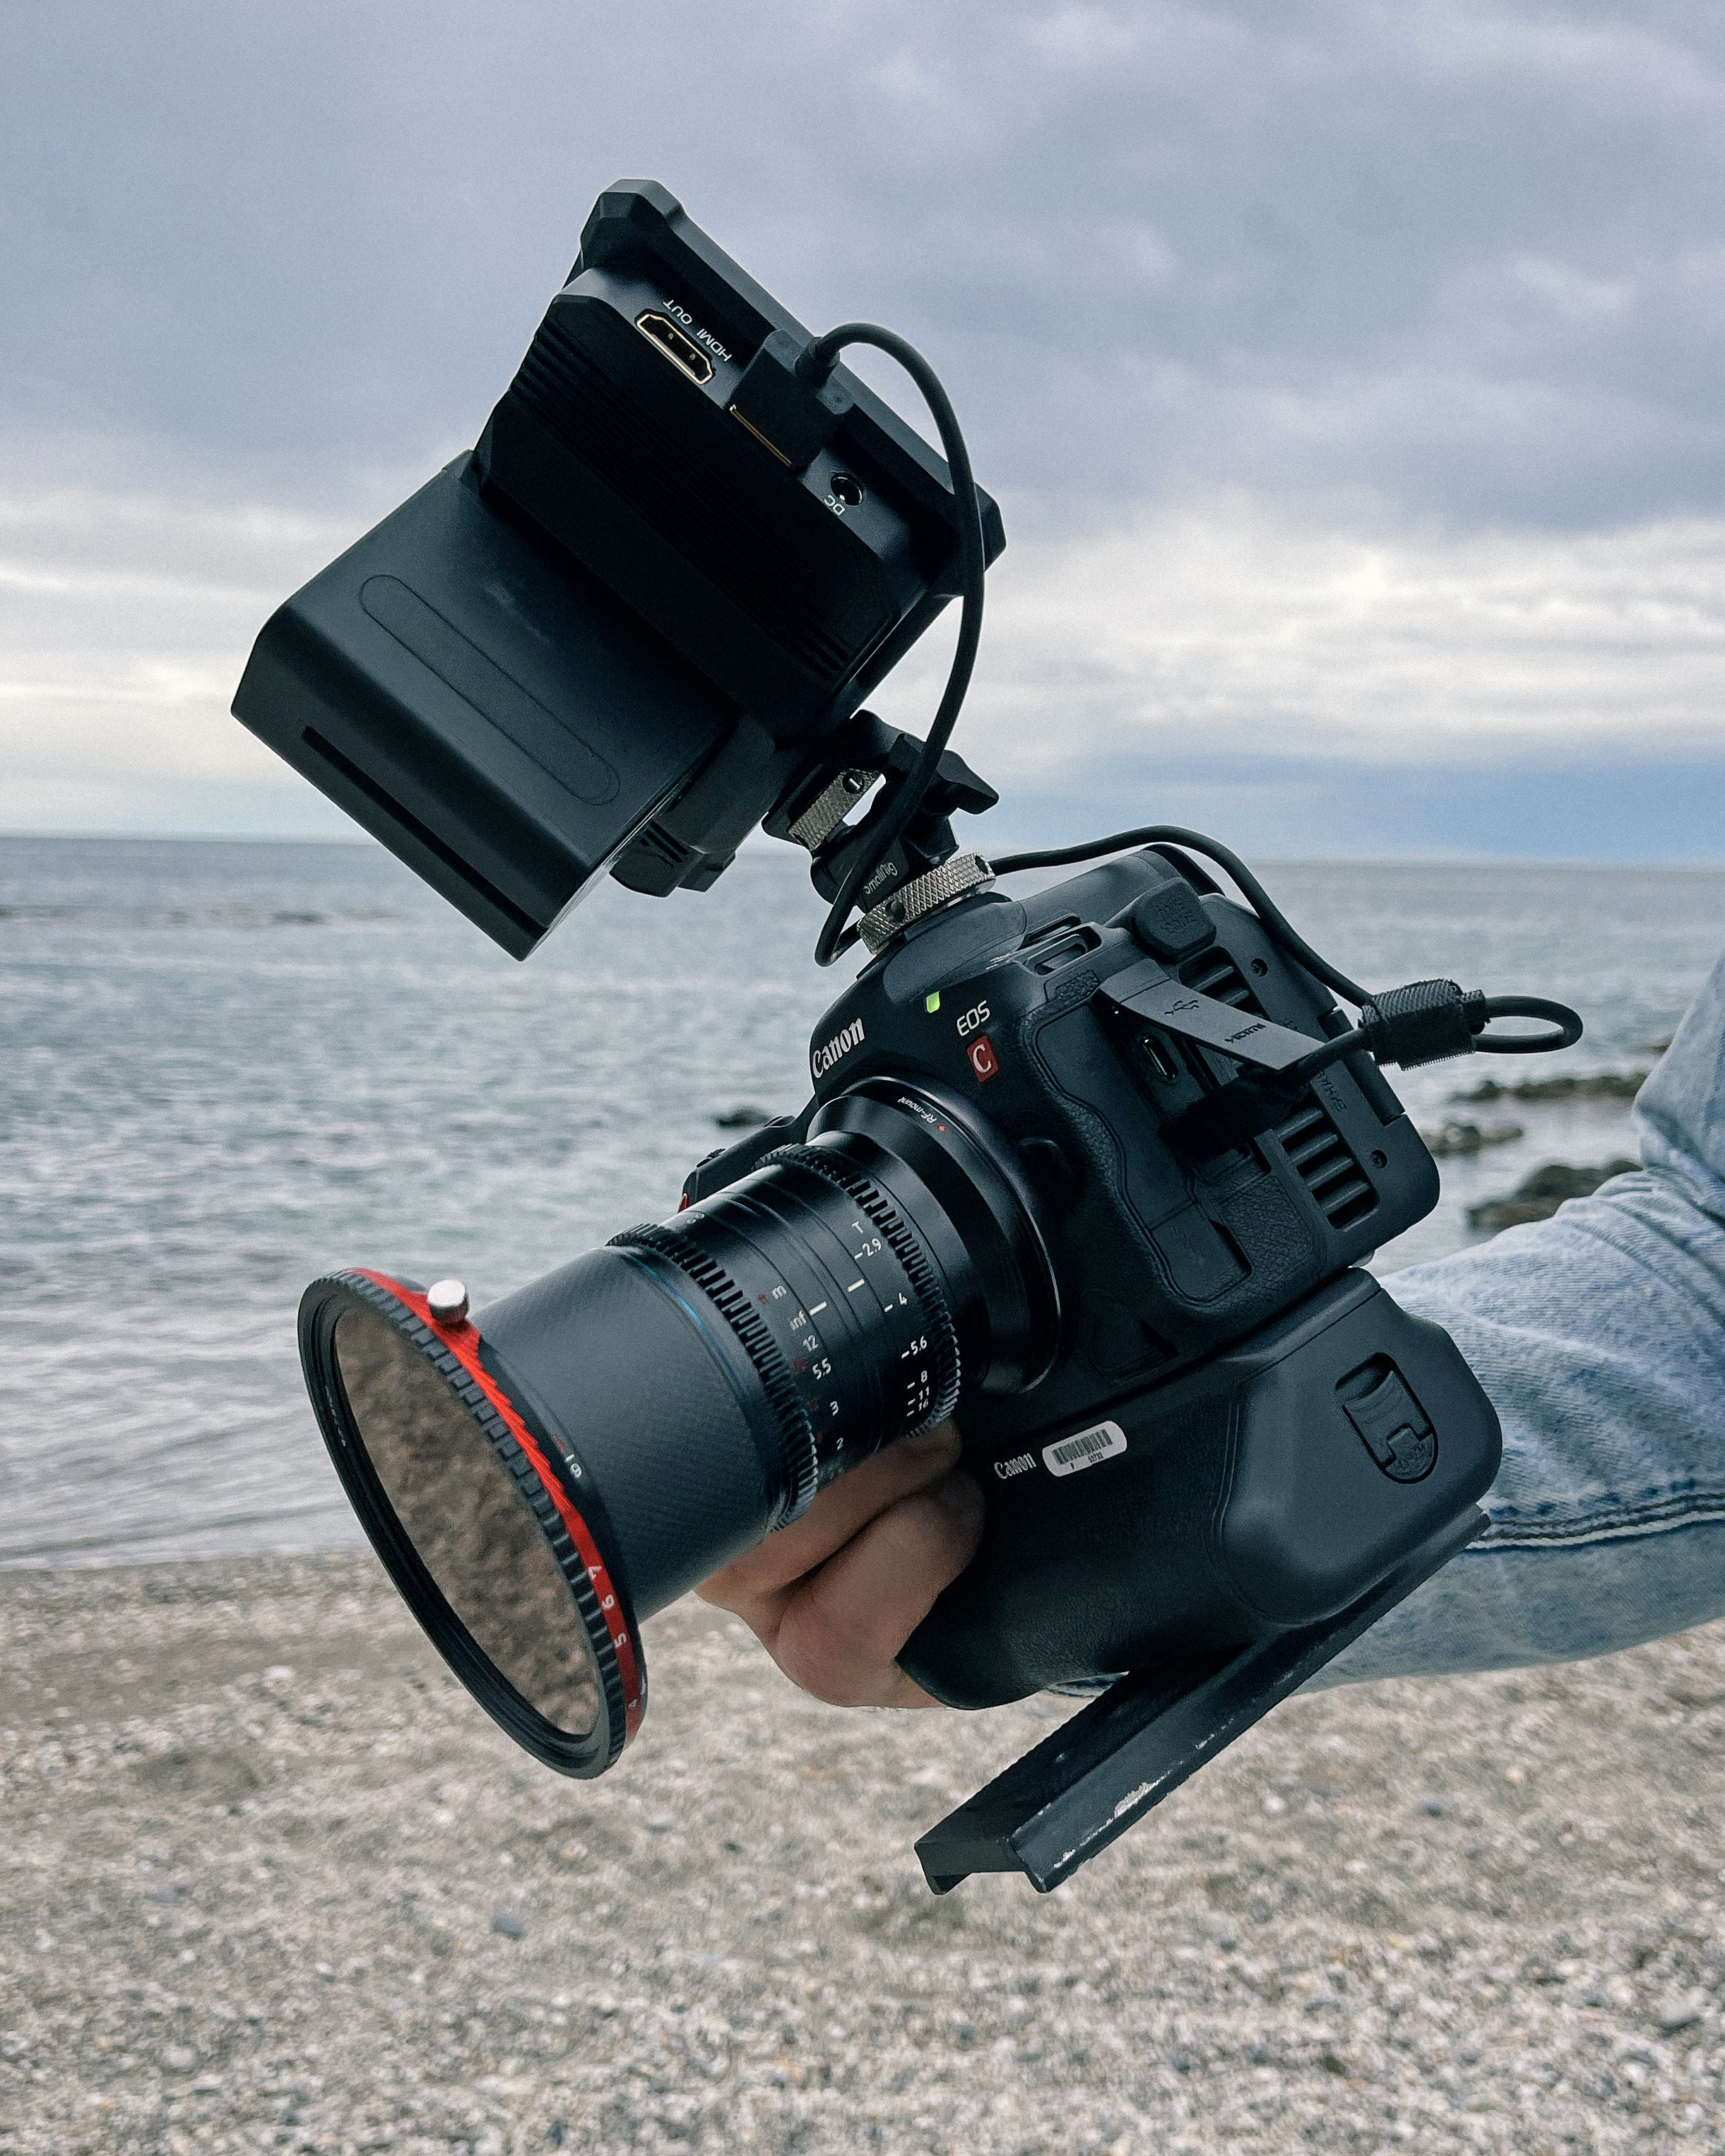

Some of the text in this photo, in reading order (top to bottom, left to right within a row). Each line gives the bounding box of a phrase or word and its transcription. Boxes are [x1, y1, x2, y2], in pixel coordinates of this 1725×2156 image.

[663, 299, 733, 362] HDMI OUT
[823, 494, 846, 516] DC
[956, 1000, 990, 1036] EOS
[812, 1018, 865, 1079] Canon
[973, 1043, 992, 1073] C
[897, 1096, 937, 1123] RF-mount
[851, 1221, 864, 1234] T
[862, 1238, 882, 1257] 2.9
[771, 1285, 787, 1300] m
[899, 1292, 907, 1305] 4
[789, 1310, 807, 1331] inf
[803, 1334, 819, 1352] 12
[911, 1335, 927, 1356] 5.6
[812, 1357, 831, 1380] 5.5
[920, 1370, 927, 1383] 8
[918, 1386, 930, 1400] 11
[829, 1401, 839, 1416] 3
[993, 1452, 1037, 1479] Canon
[588, 1565, 603, 1581] 7
[601, 1594, 615, 1610] 6
[613, 1632, 627, 1649] 5
